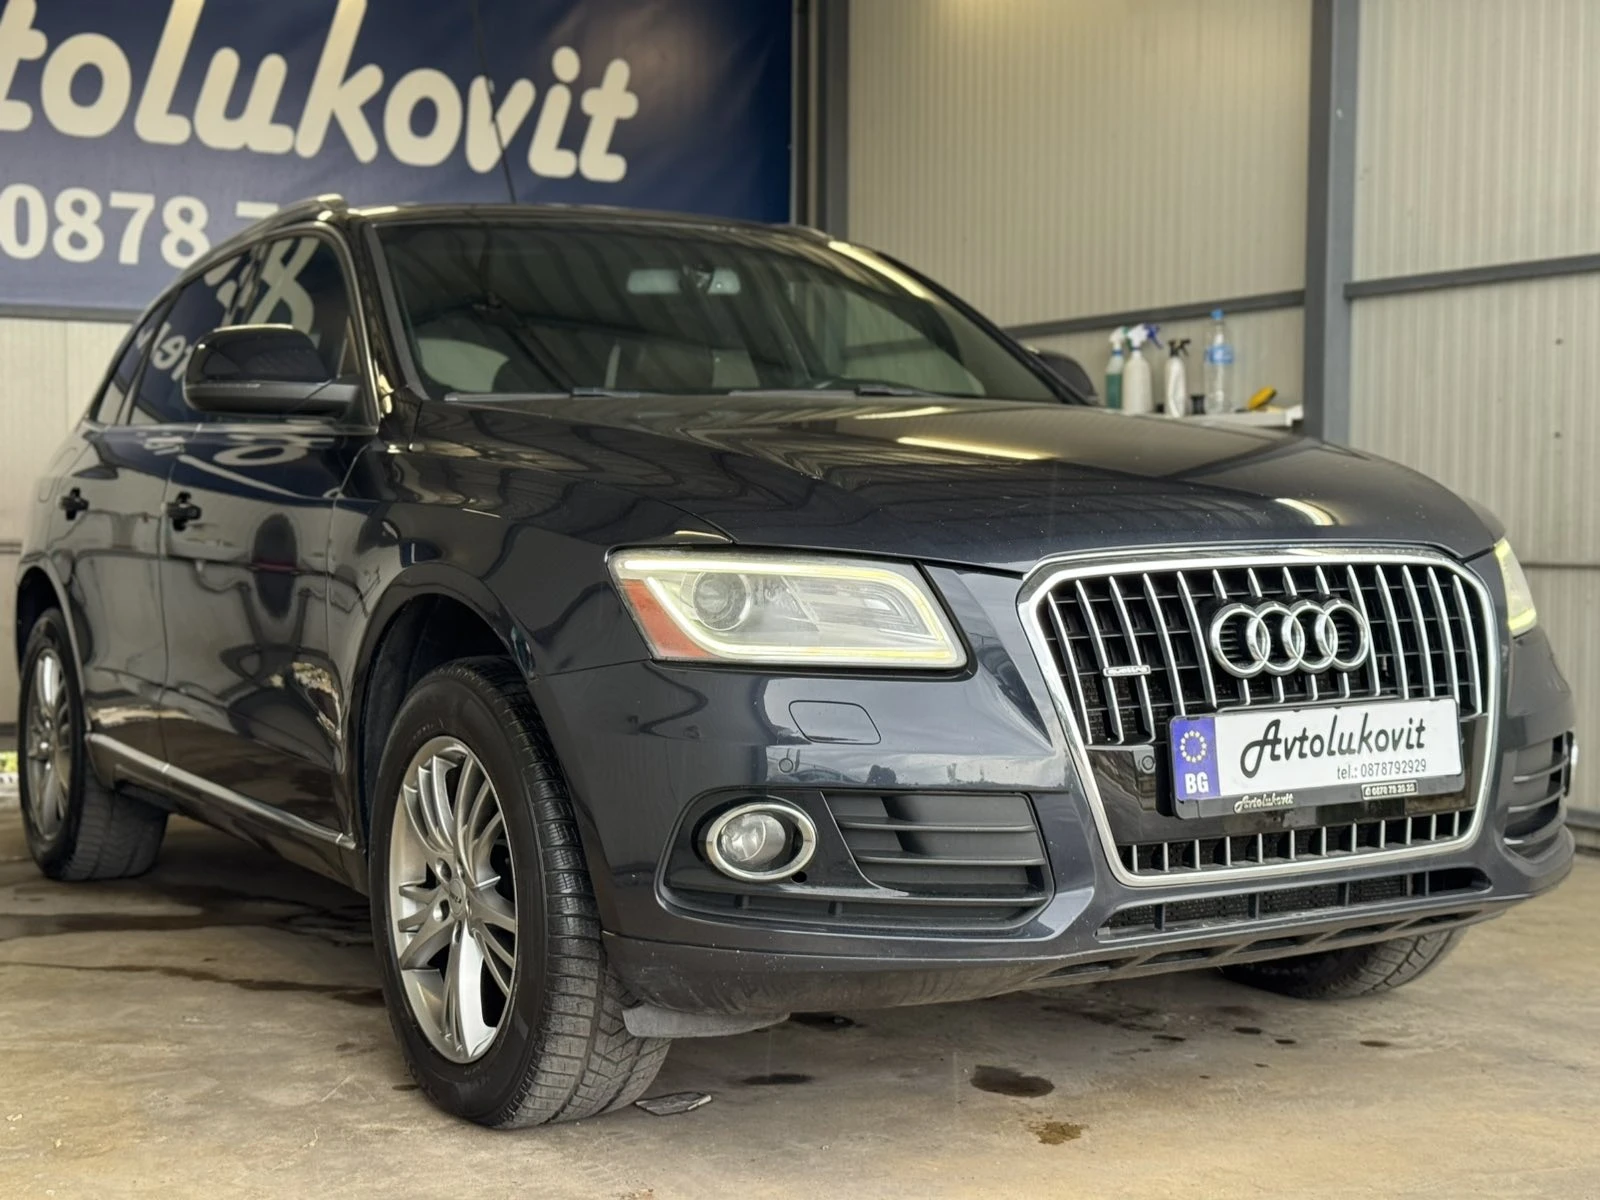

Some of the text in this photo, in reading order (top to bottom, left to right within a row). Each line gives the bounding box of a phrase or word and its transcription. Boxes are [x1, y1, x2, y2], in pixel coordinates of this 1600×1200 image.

[0, 183, 211, 269] 0878
[1240, 712, 1426, 778] Avtolukovit
[1184, 772, 1210, 795] BG
[1337, 758, 1427, 780] tel.: 0878792929
